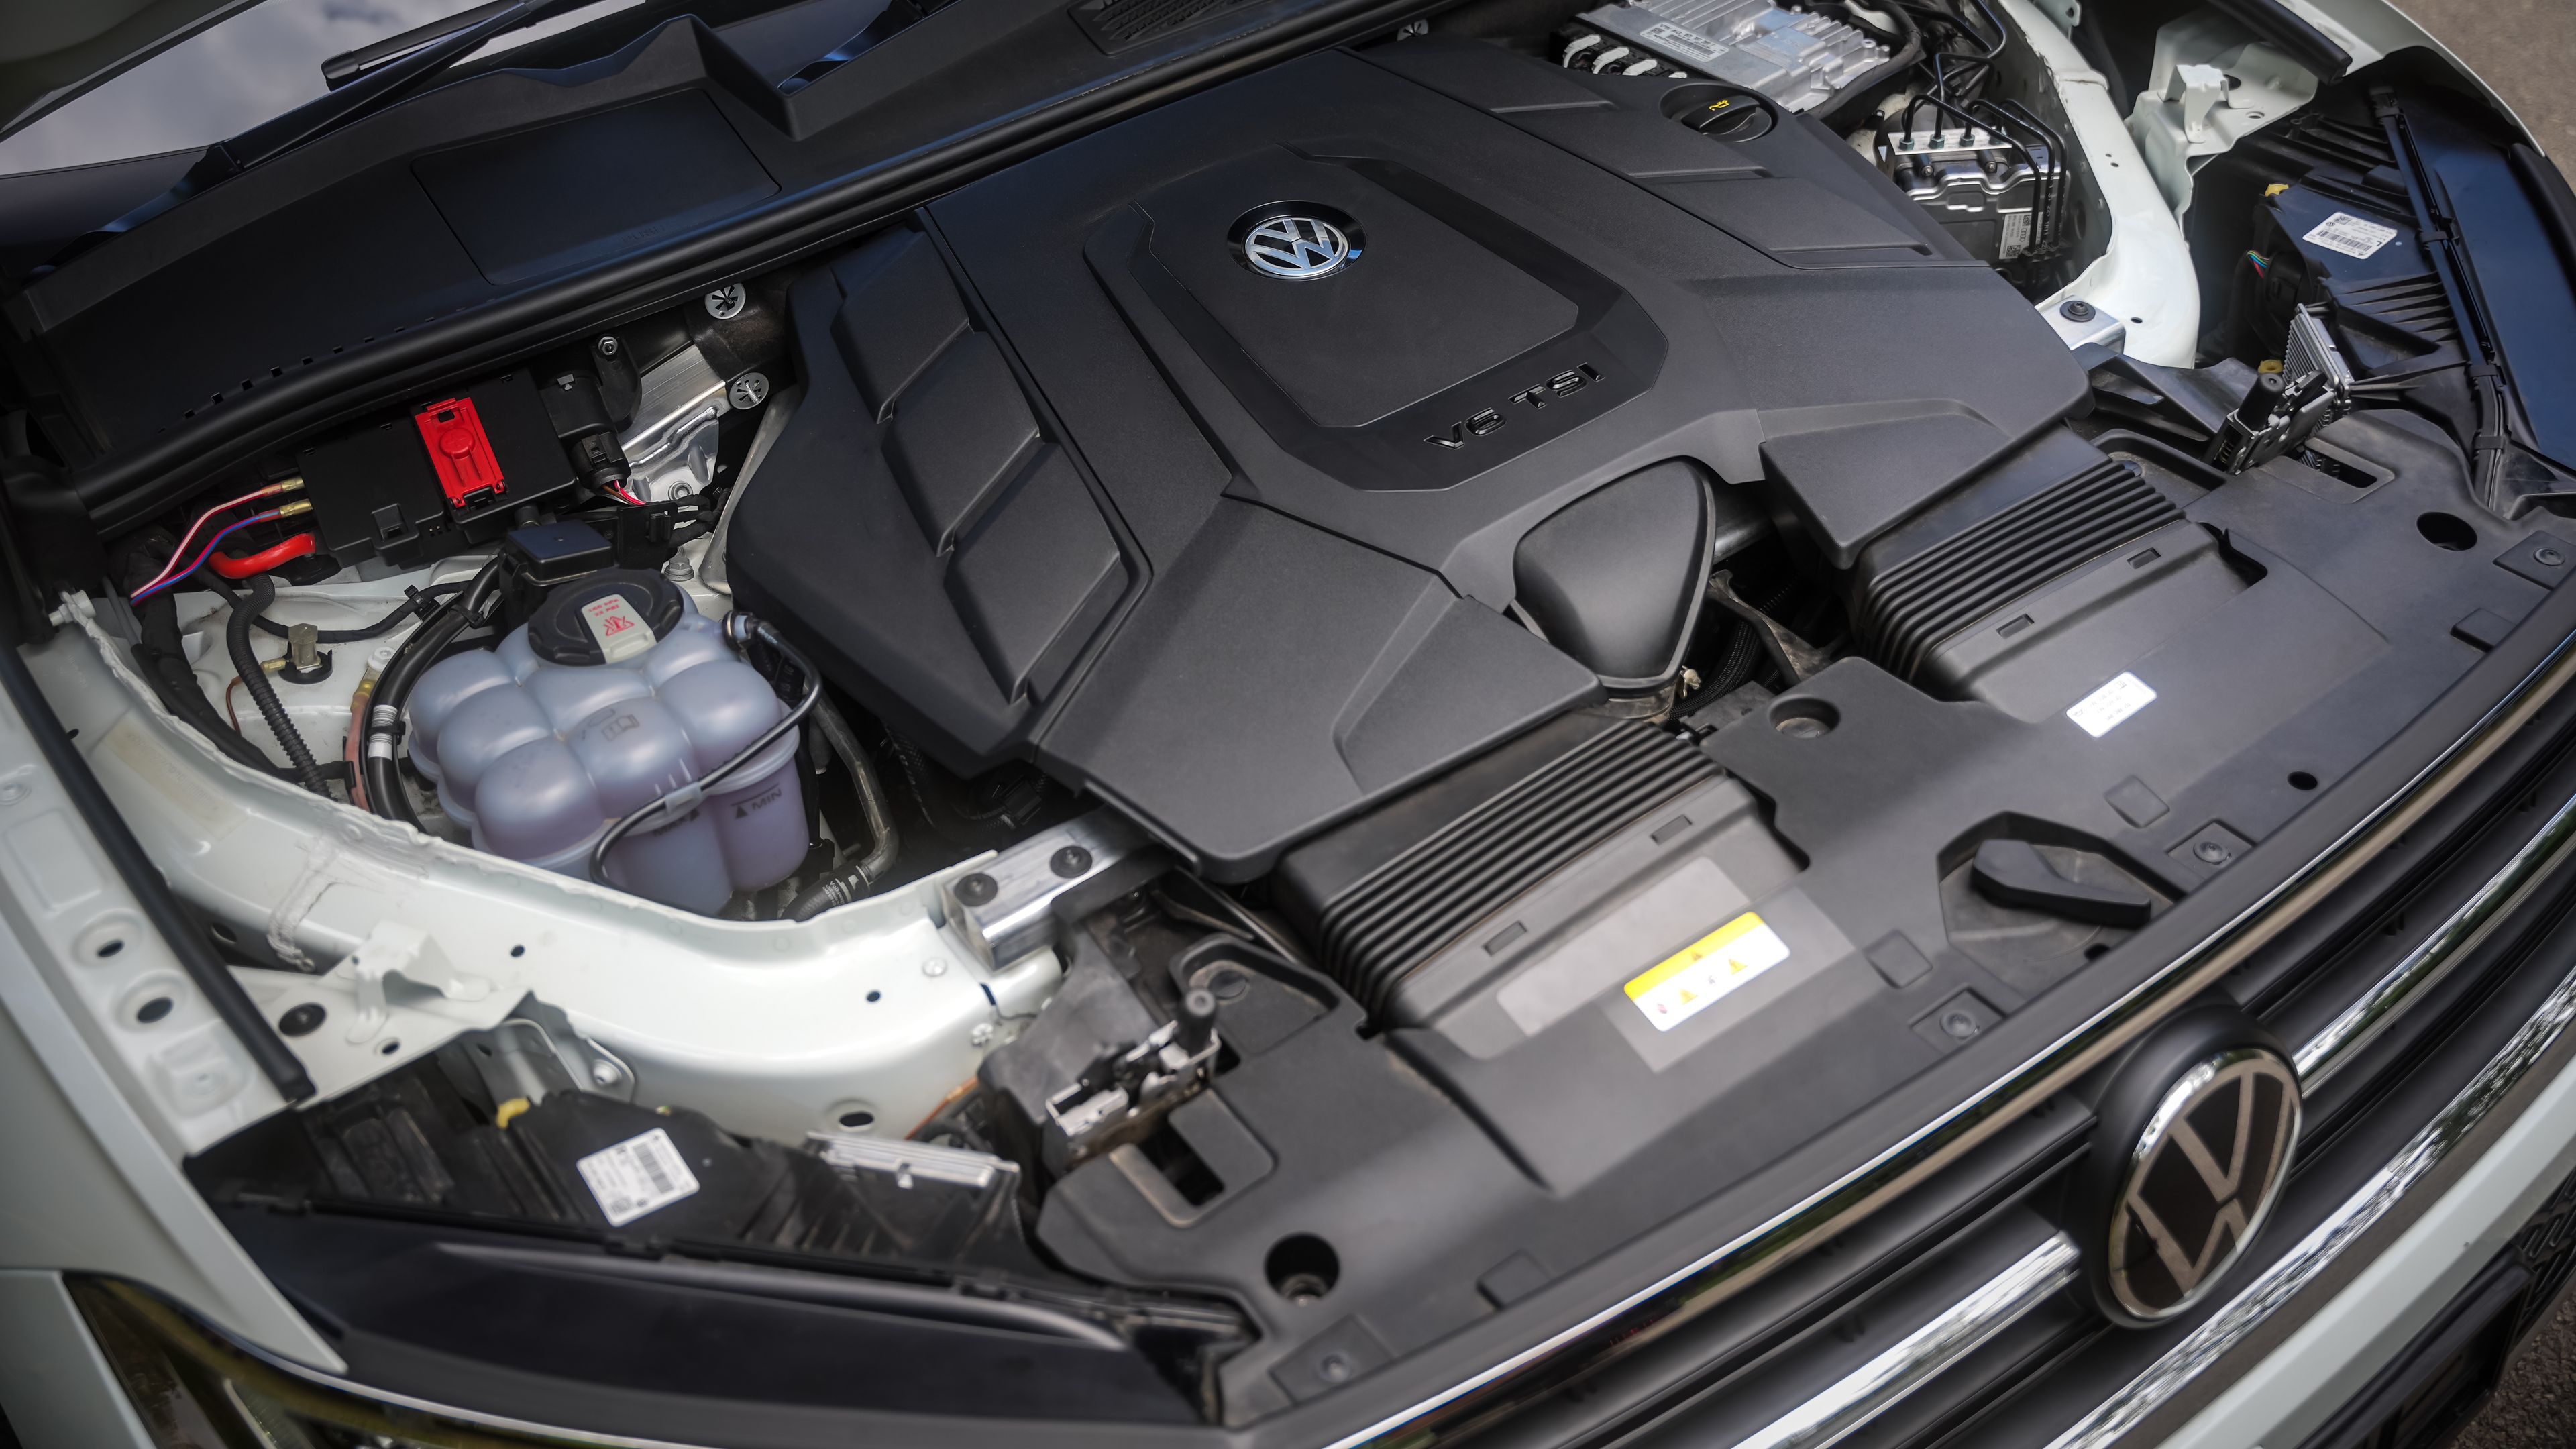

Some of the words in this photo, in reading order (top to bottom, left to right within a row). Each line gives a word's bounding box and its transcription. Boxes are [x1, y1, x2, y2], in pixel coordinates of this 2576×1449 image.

[1423, 407, 1507, 450] V6
[1507, 362, 1605, 410] TSI
[751, 788, 782, 811] MIN
